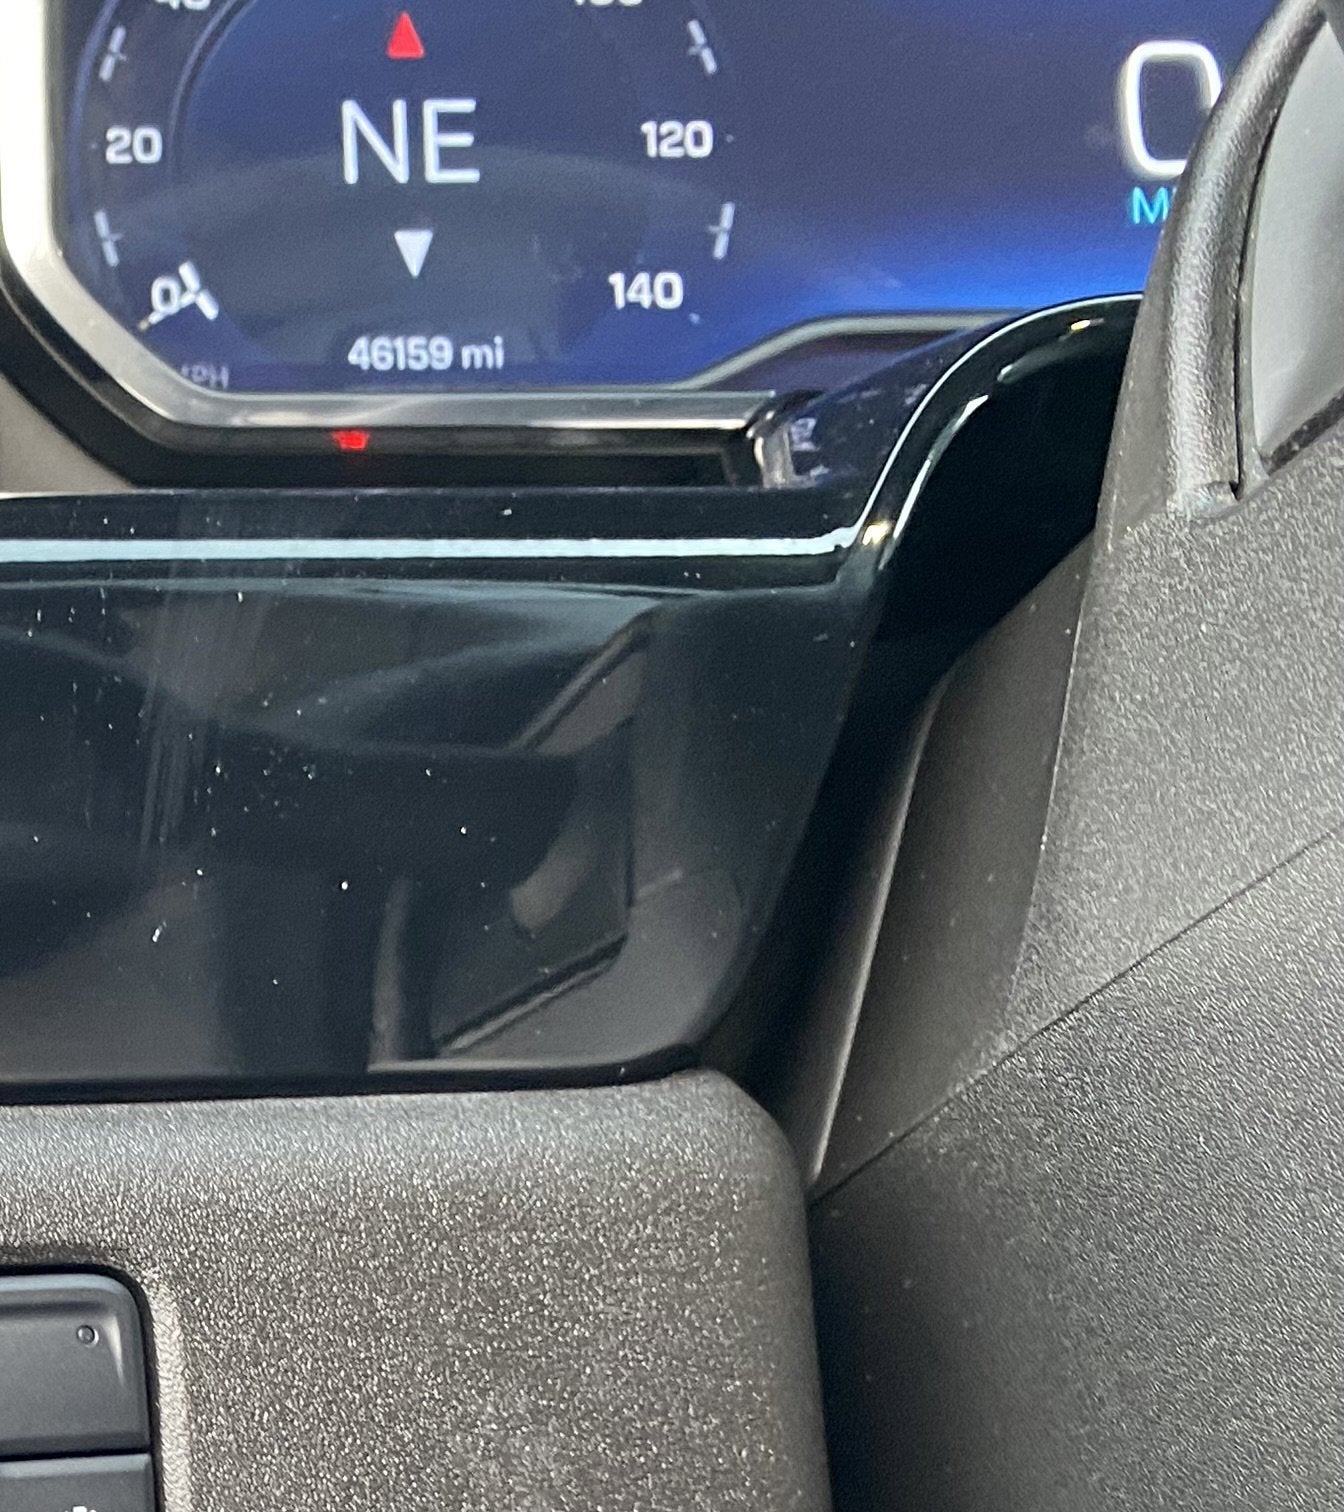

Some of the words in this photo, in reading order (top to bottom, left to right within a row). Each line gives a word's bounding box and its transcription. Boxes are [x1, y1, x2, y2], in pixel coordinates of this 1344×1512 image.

[105, 126, 162, 164] 20
[341, 98, 481, 185] NE
[640, 120, 714, 158] 120
[1131, 186, 1177, 224] M
[608, 271, 684, 310] 140
[347, 335, 454, 371] 46159
[461, 335, 505, 370] mi
